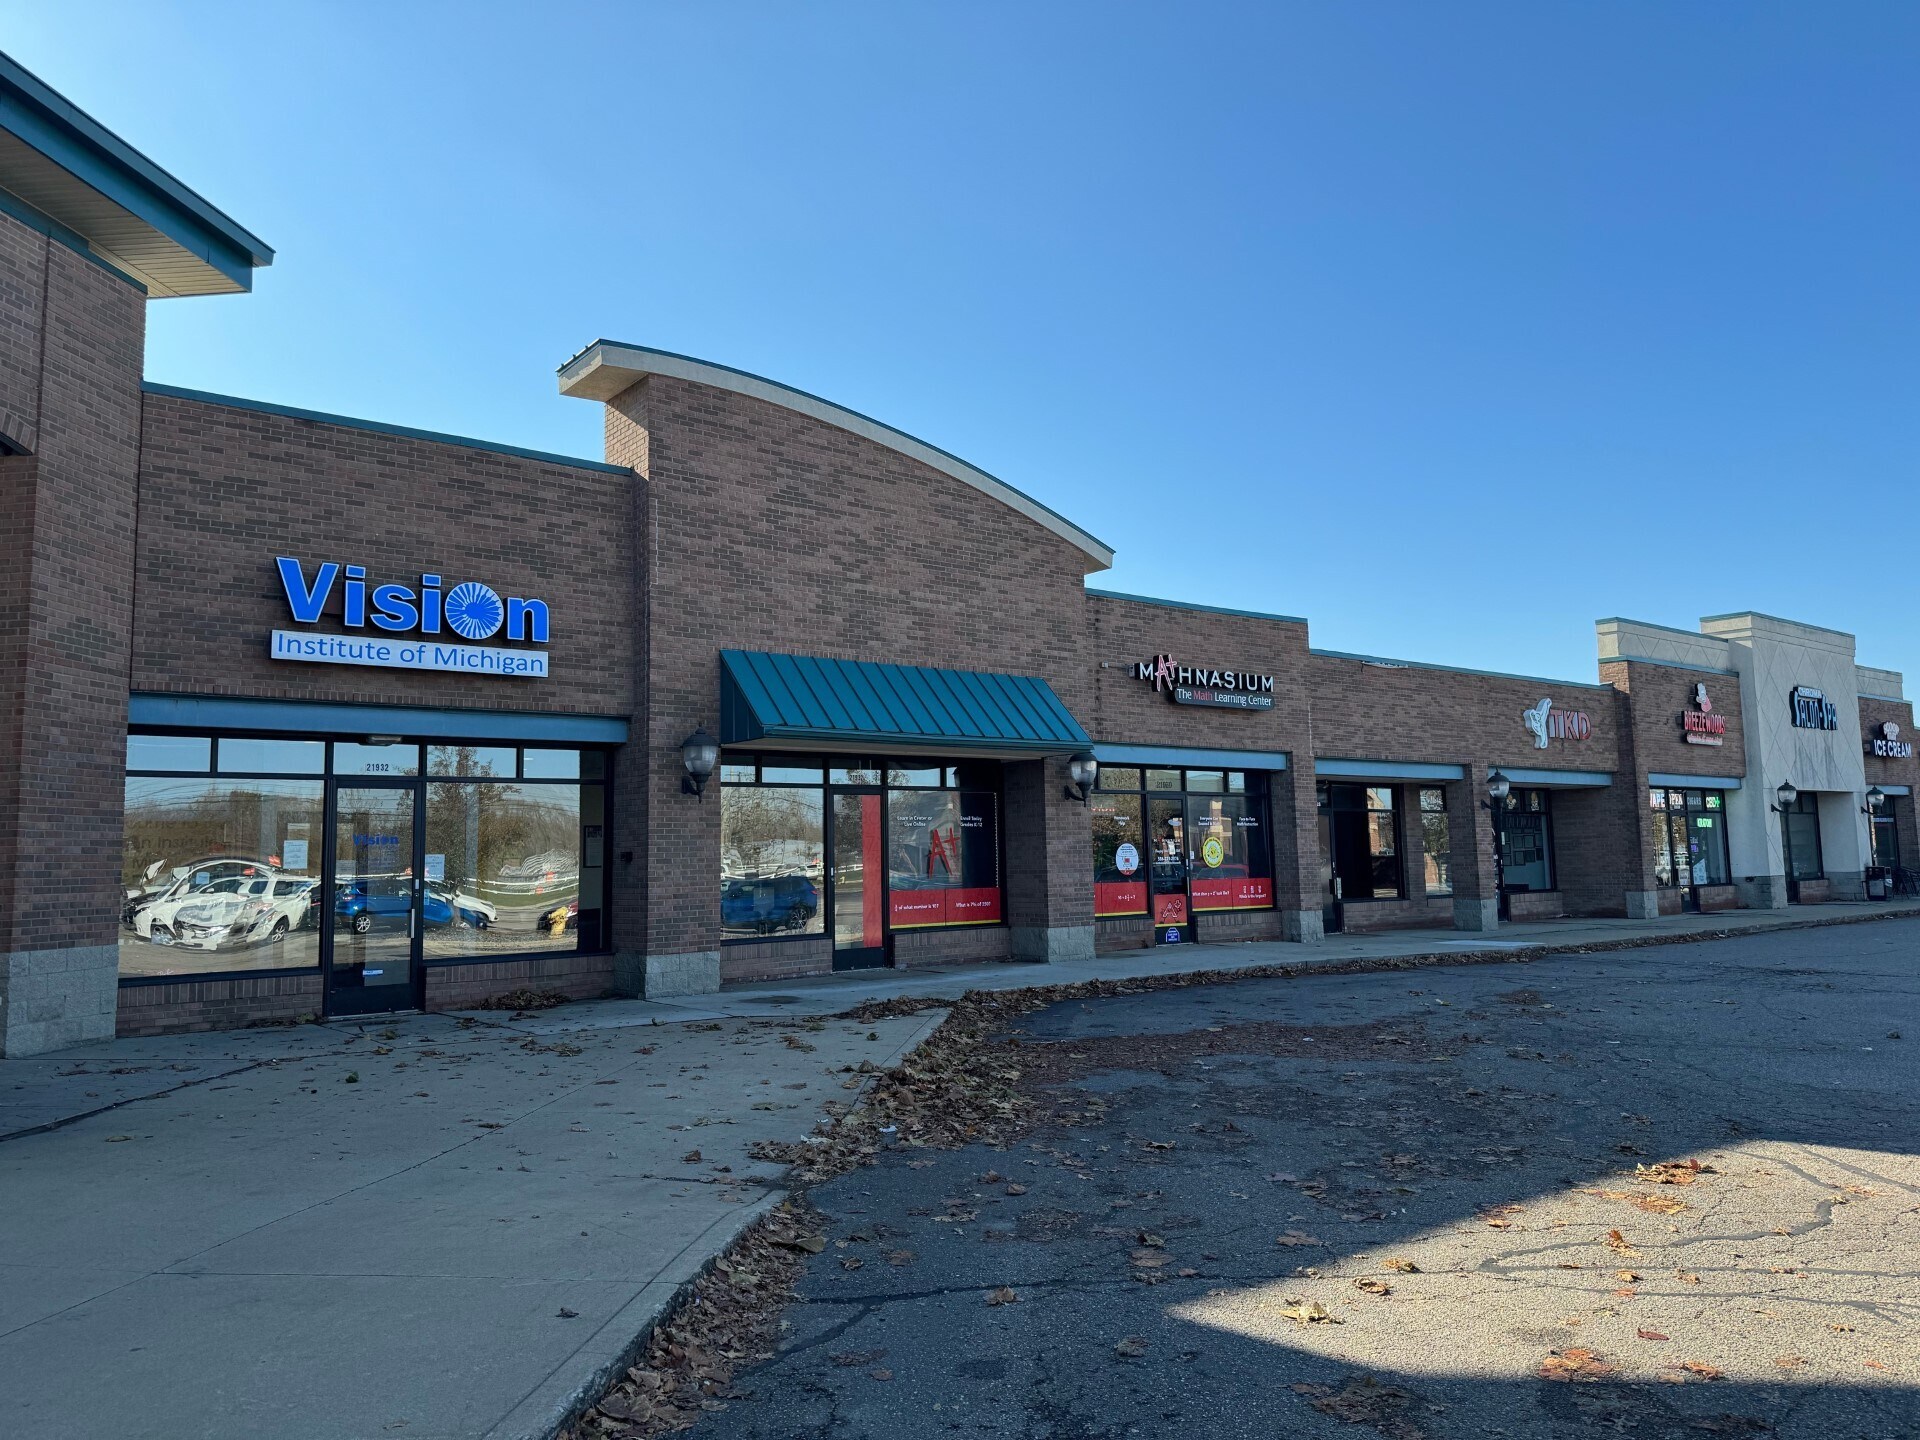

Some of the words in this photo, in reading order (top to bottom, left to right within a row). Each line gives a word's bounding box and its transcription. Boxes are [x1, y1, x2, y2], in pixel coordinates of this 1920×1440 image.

[276, 557, 549, 642] Vision
[278, 634, 391, 661] Institute
[400, 645, 427, 663] of
[434, 647, 543, 673] Michigan
[1139, 654, 1274, 692] MATHNASIUM
[1177, 689, 1192, 700] The
[1193, 690, 1213, 701] Math
[1214, 691, 1247, 707] Learning
[1249, 695, 1272, 706] Center
[1550, 709, 1591, 740] TKD
[1684, 711, 1726, 735] BREEZEWOODS
[1874, 739, 1887, 757] ICE
[1887, 740, 1912, 758] CREAM
[366, 763, 389, 772] 21932
[353, 834, 399, 846] Vision
